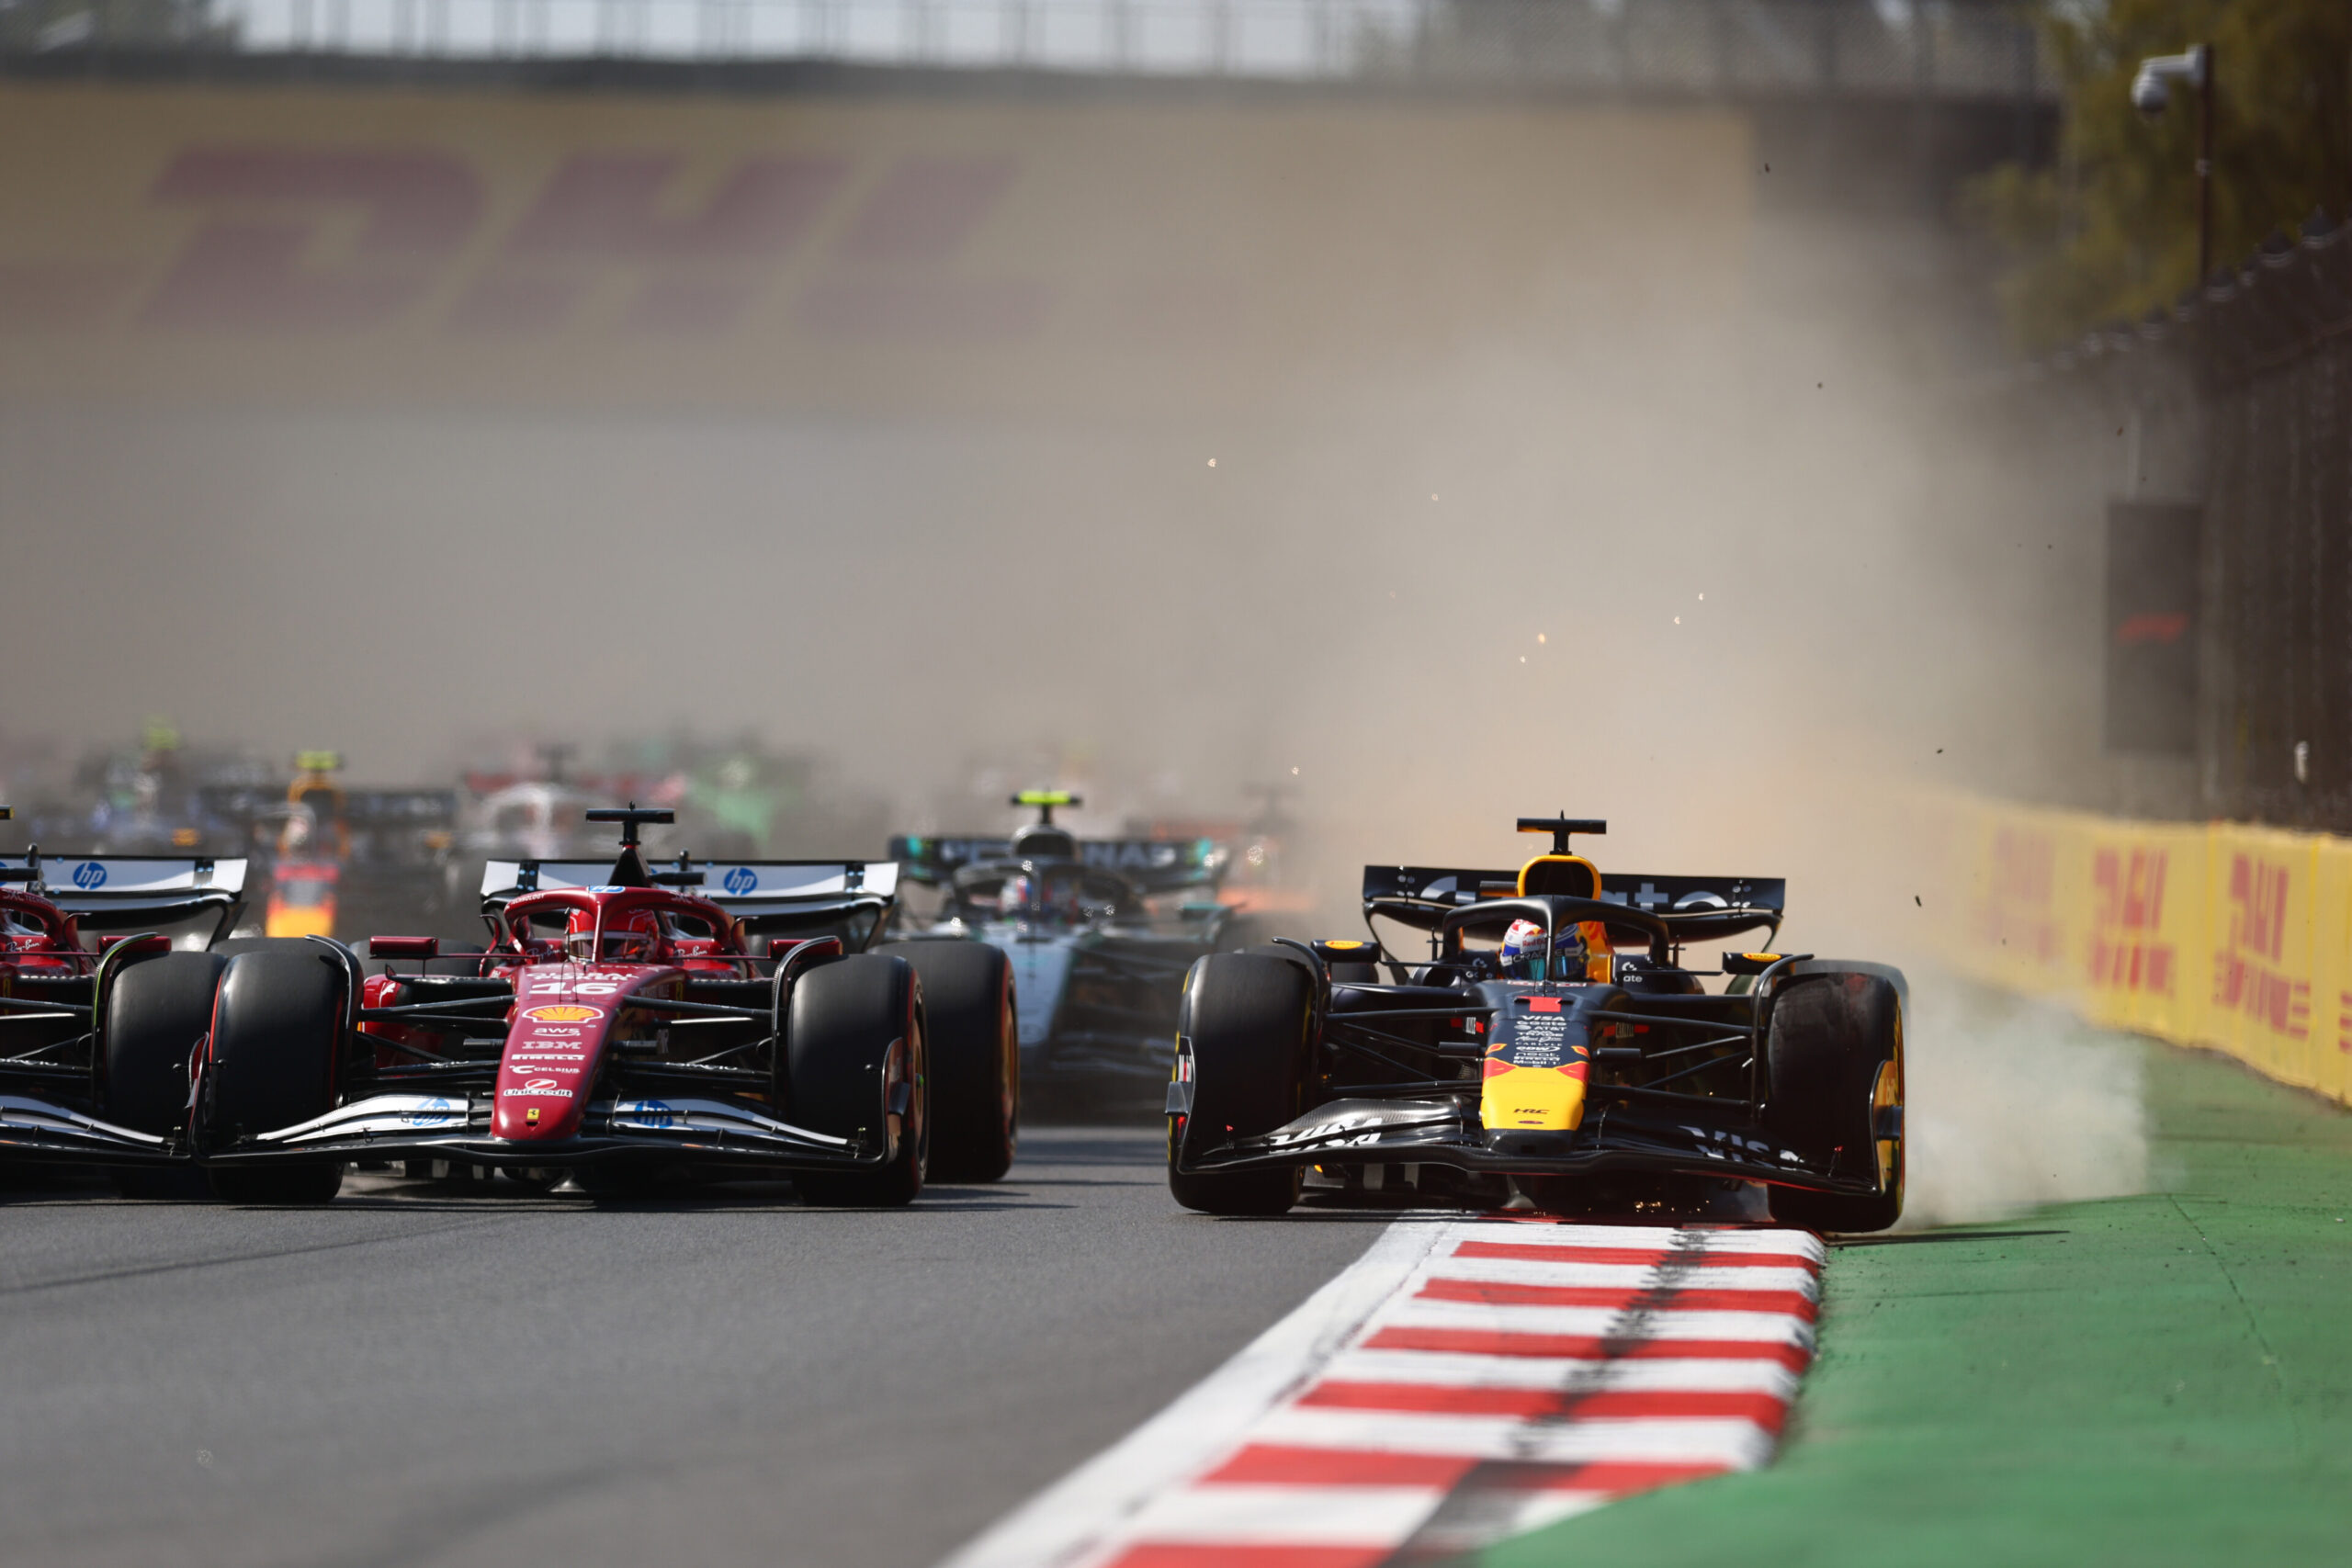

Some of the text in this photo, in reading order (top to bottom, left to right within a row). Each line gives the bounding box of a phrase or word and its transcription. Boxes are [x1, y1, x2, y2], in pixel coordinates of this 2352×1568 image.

[130, 144, 1058, 340] DHL
[74, 861, 106, 890] hp
[724, 867, 756, 896] hp
[1513, 948, 1564, 964] ORACE
[529, 982, 617, 995] 16
[533, 1027, 581, 1035] aws
[522, 1041, 582, 1050] IBM
[503, 1089, 573, 1098] UniCredit
